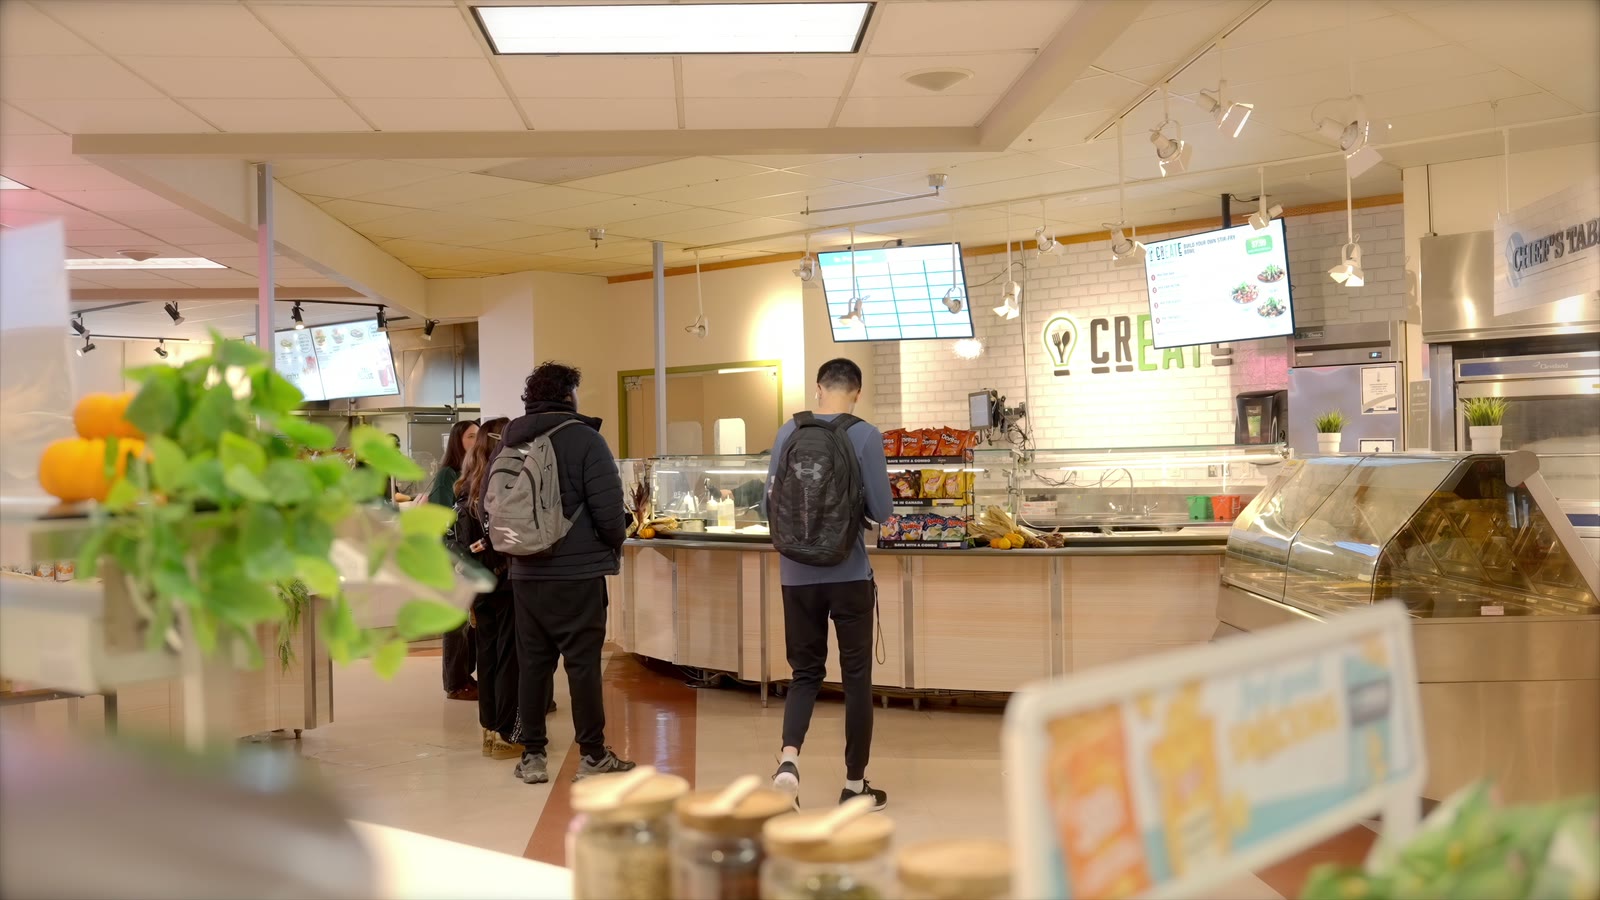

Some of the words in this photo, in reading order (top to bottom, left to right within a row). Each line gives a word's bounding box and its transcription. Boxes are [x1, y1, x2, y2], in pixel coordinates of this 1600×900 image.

[1155, 242, 1183, 260] CREATE
[1514, 231, 1565, 272] CHEF'S
[1090, 314, 1233, 374] CRE
[941, 433, 960, 445] Doritos
